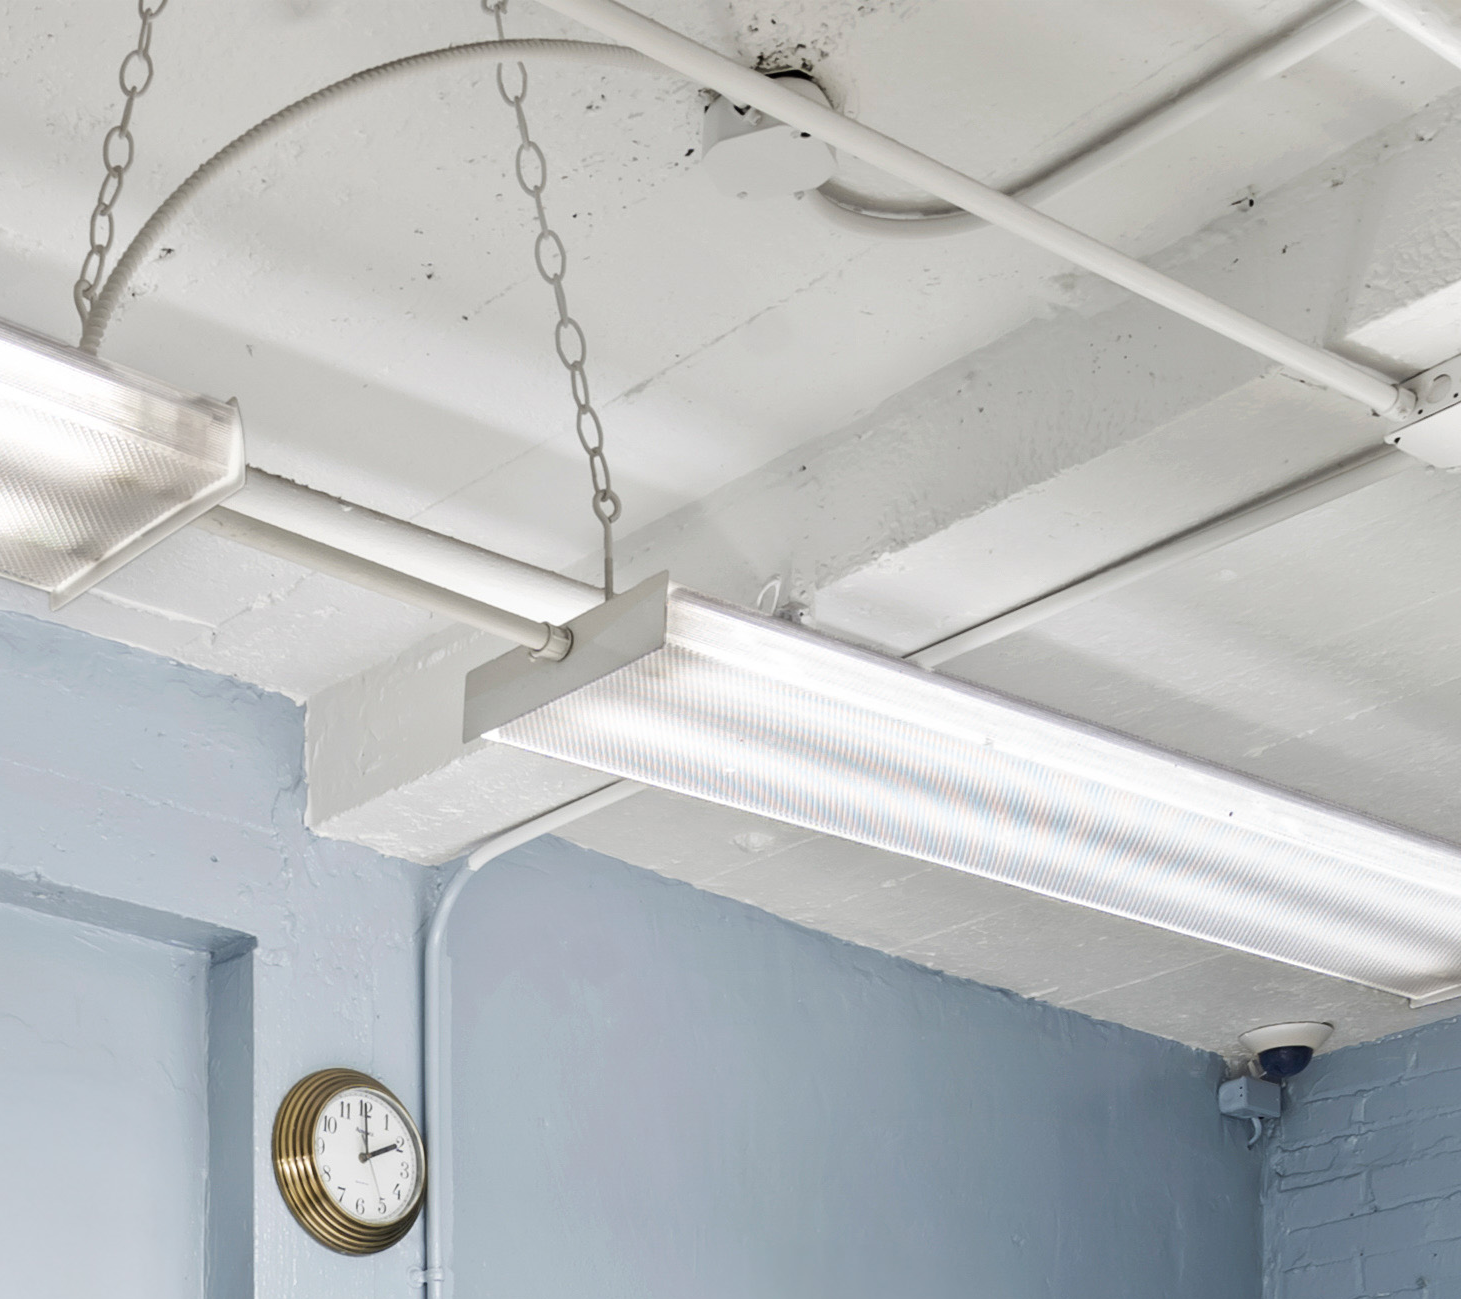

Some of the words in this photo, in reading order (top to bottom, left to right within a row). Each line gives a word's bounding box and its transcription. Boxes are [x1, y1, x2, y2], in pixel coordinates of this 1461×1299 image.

[340, 1101, 351, 1120] 11
[323, 1115, 337, 1134] 10
[384, 1113, 390, 1131] 1
[317, 1137, 325, 1154] 9
[395, 1136, 405, 1153] 2
[321, 1165, 331, 1182] 8
[400, 1162, 410, 1179] 3
[337, 1186, 346, 1203] 7
[393, 1183, 401, 1200] 4
[355, 1198, 365, 1215] 6
[378, 1197, 387, 1214] 5
